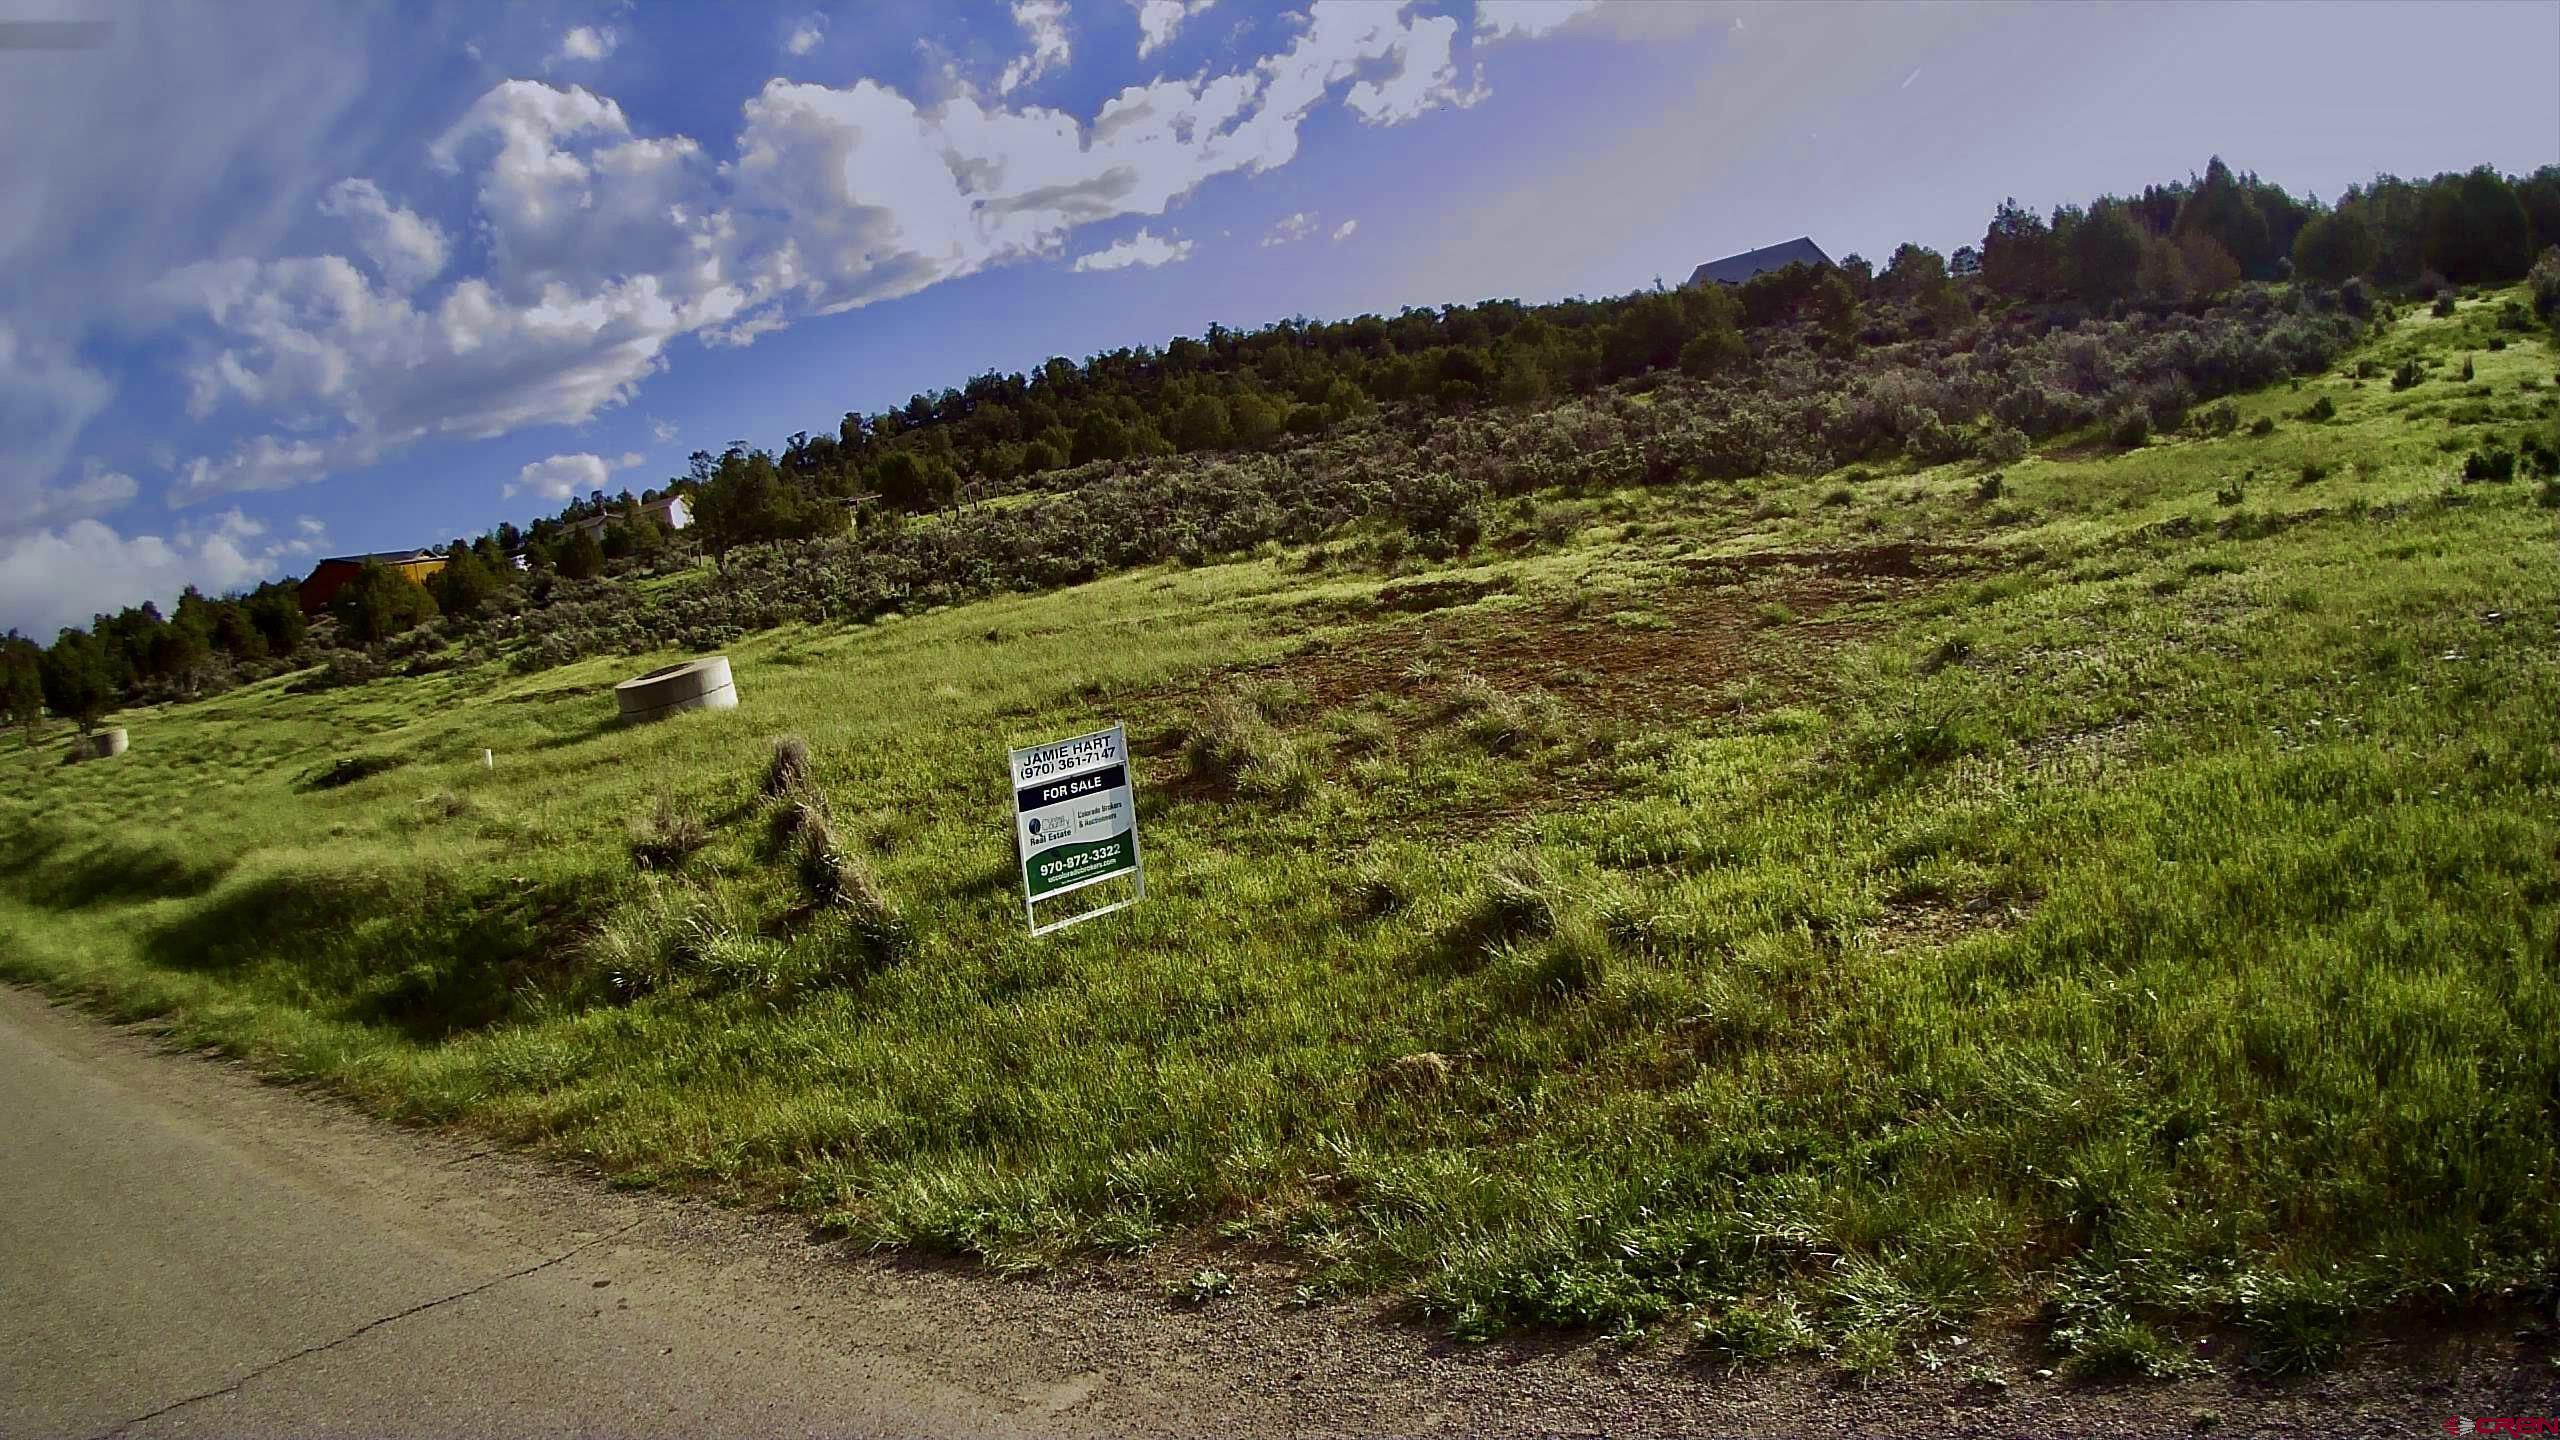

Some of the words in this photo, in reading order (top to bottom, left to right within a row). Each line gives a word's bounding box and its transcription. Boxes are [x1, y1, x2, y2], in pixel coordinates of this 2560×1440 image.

[1020, 763, 1054, 780] (970)
[1058, 747, 1116, 770] 361-7147
[1024, 746, 1069, 767] JAMIE
[1073, 736, 1111, 755] HART
[1043, 785, 1067, 801] FOR
[1070, 776, 1102, 794] SALE
[1030, 836, 1047, 846] Real
[1048, 829, 1072, 841] Estate
[1040, 843, 1121, 876] 970-872-3322
